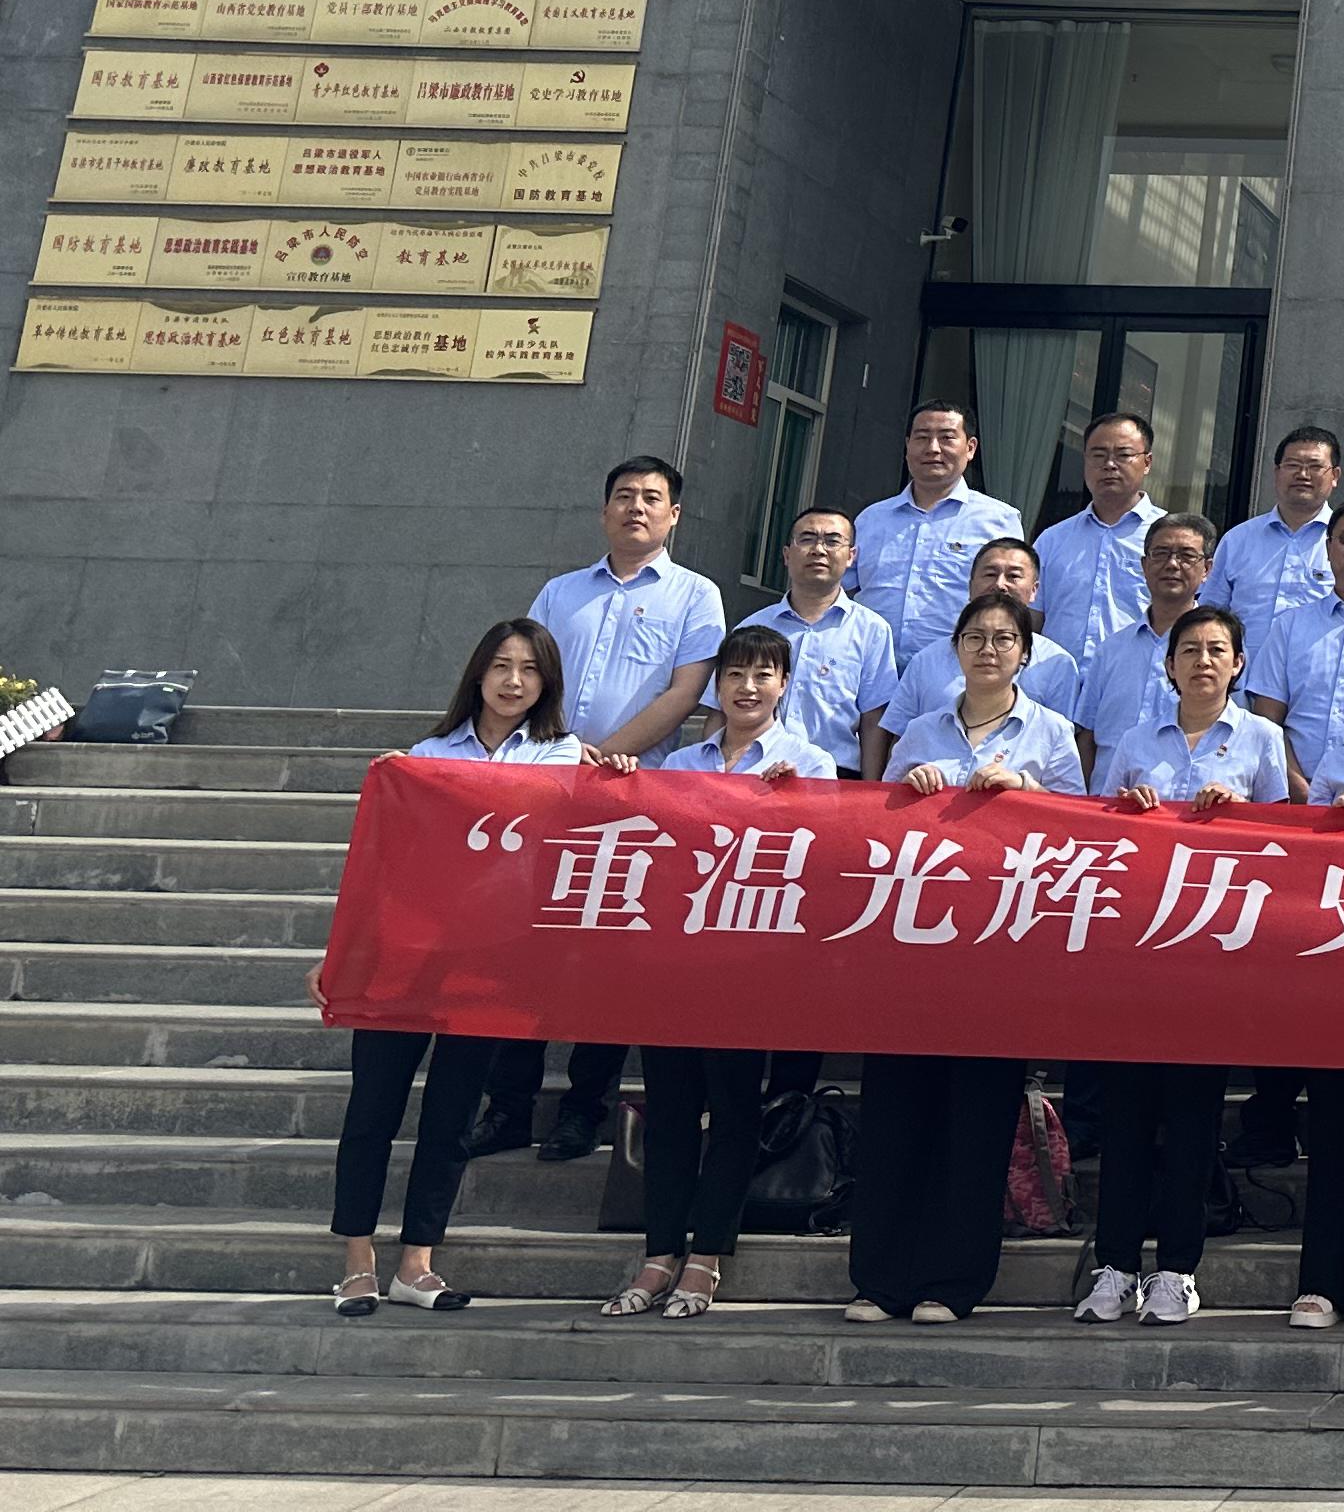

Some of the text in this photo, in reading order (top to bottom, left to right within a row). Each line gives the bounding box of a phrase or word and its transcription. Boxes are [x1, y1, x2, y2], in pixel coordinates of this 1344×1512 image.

[106, 0, 198, 12] 国家国防教育示范基地
[216, 3, 306, 18] 山西省党史教育基地
[326, 1, 418, 17] 党员干部教育基地
[543, 7, 636, 20] 爱国主义教育示范基地
[91, 70, 180, 90] 国防教育基地
[311, 83, 400, 99] 青少年红色教育基地
[416, 81, 515, 102] 吕梁市廉政教育基地
[529, 87, 622, 103] 党史学习教育基地
[302, 148, 382, 160] 吕梁市退役军人
[70, 156, 165, 172] 吕梁市党员干部教育基地
[183, 156, 271, 176] 廉政教育基地
[292, 163, 386, 177] 思想政治教育基地
[518, 150, 605, 181] 中共吕梁市委党校
[404, 171, 495, 183] 中国农业银行山西省分行
[415, 186, 480, 198] 党员教育实践基地
[513, 188, 603, 202] 国防教育基地
[52, 234, 143, 255] 国防教育基地
[163, 238, 258, 255] 思想政治教育实践基地
[274, 225, 369, 263] 吕梁市人民防空
[396, 248, 470, 267] 教育基地
[286, 271, 352, 284] 宣传教育基地
[32, 324, 128, 342] 革命传统教育基地
[143, 331, 243, 348] 思想政治教育基地
[261, 326, 352, 347] 红色教育基地
[373, 329, 432, 341] 思想政治教育
[433, 334, 468, 353] 基地
